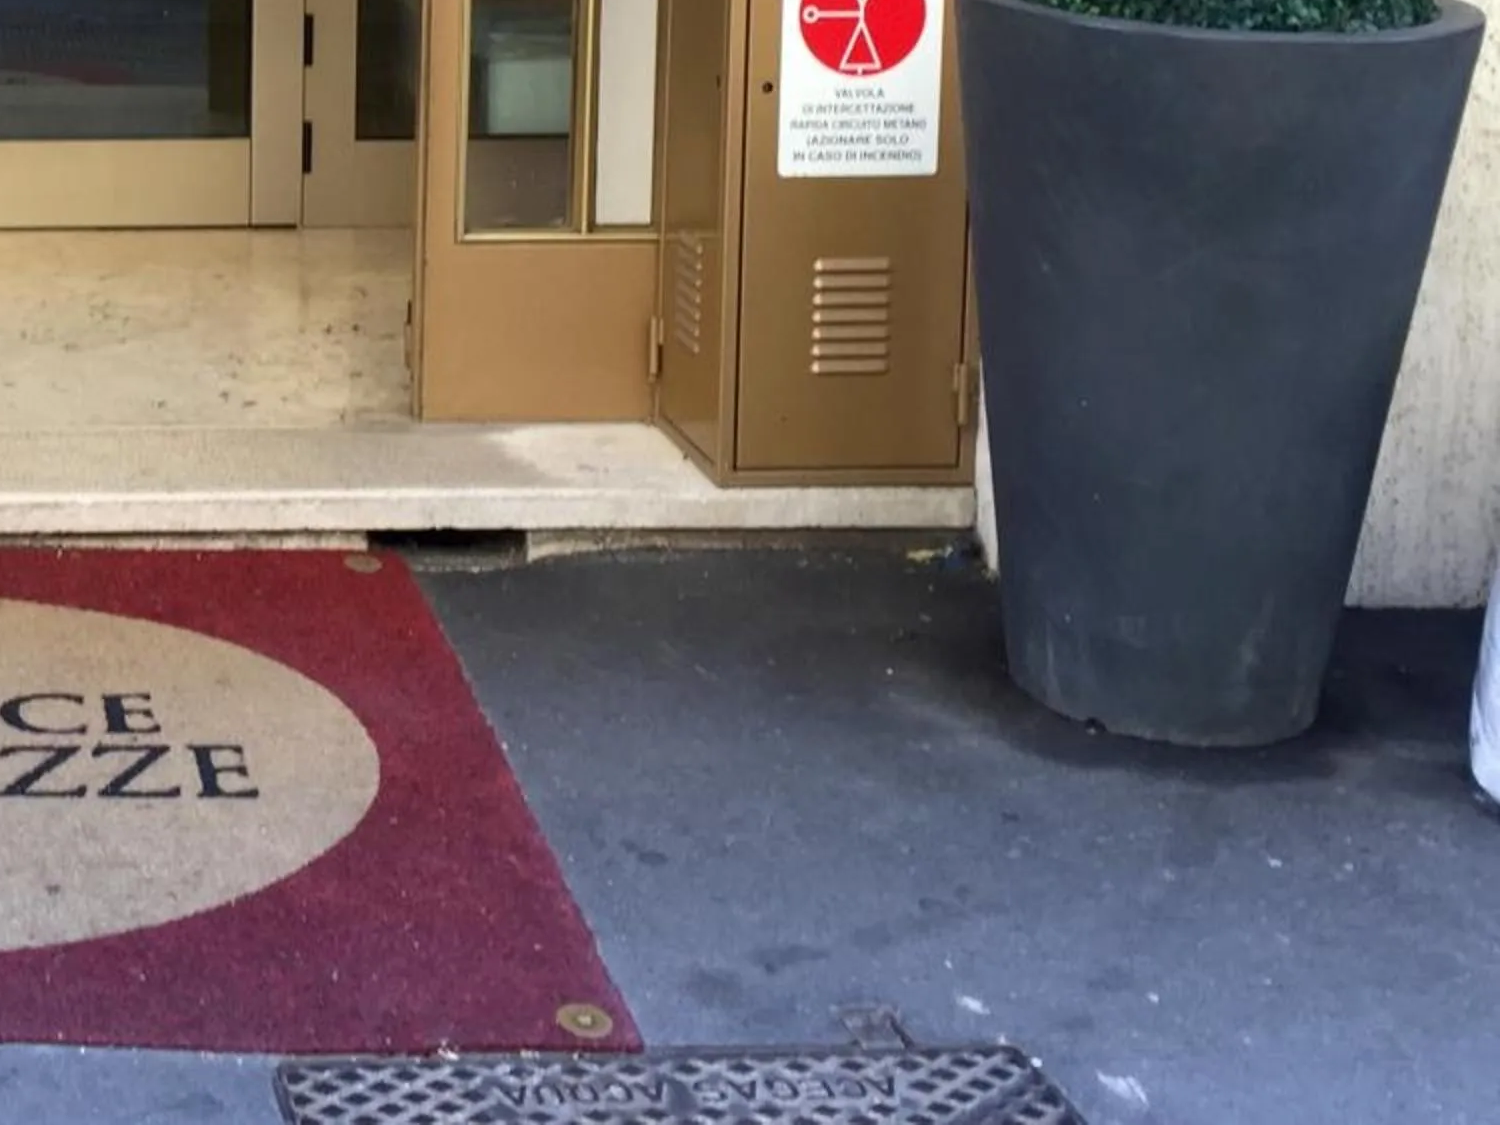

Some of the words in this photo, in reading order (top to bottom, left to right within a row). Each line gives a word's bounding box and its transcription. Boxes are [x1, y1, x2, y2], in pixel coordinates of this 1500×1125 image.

[834, 87, 885, 99] VALVOLA
[816, 102, 914, 115] INTERCETTAZIONE
[875, 133, 910, 146] SOLO
[500, 1081, 668, 1109] ACQUA
[696, 1074, 900, 1103] ACEGAS
